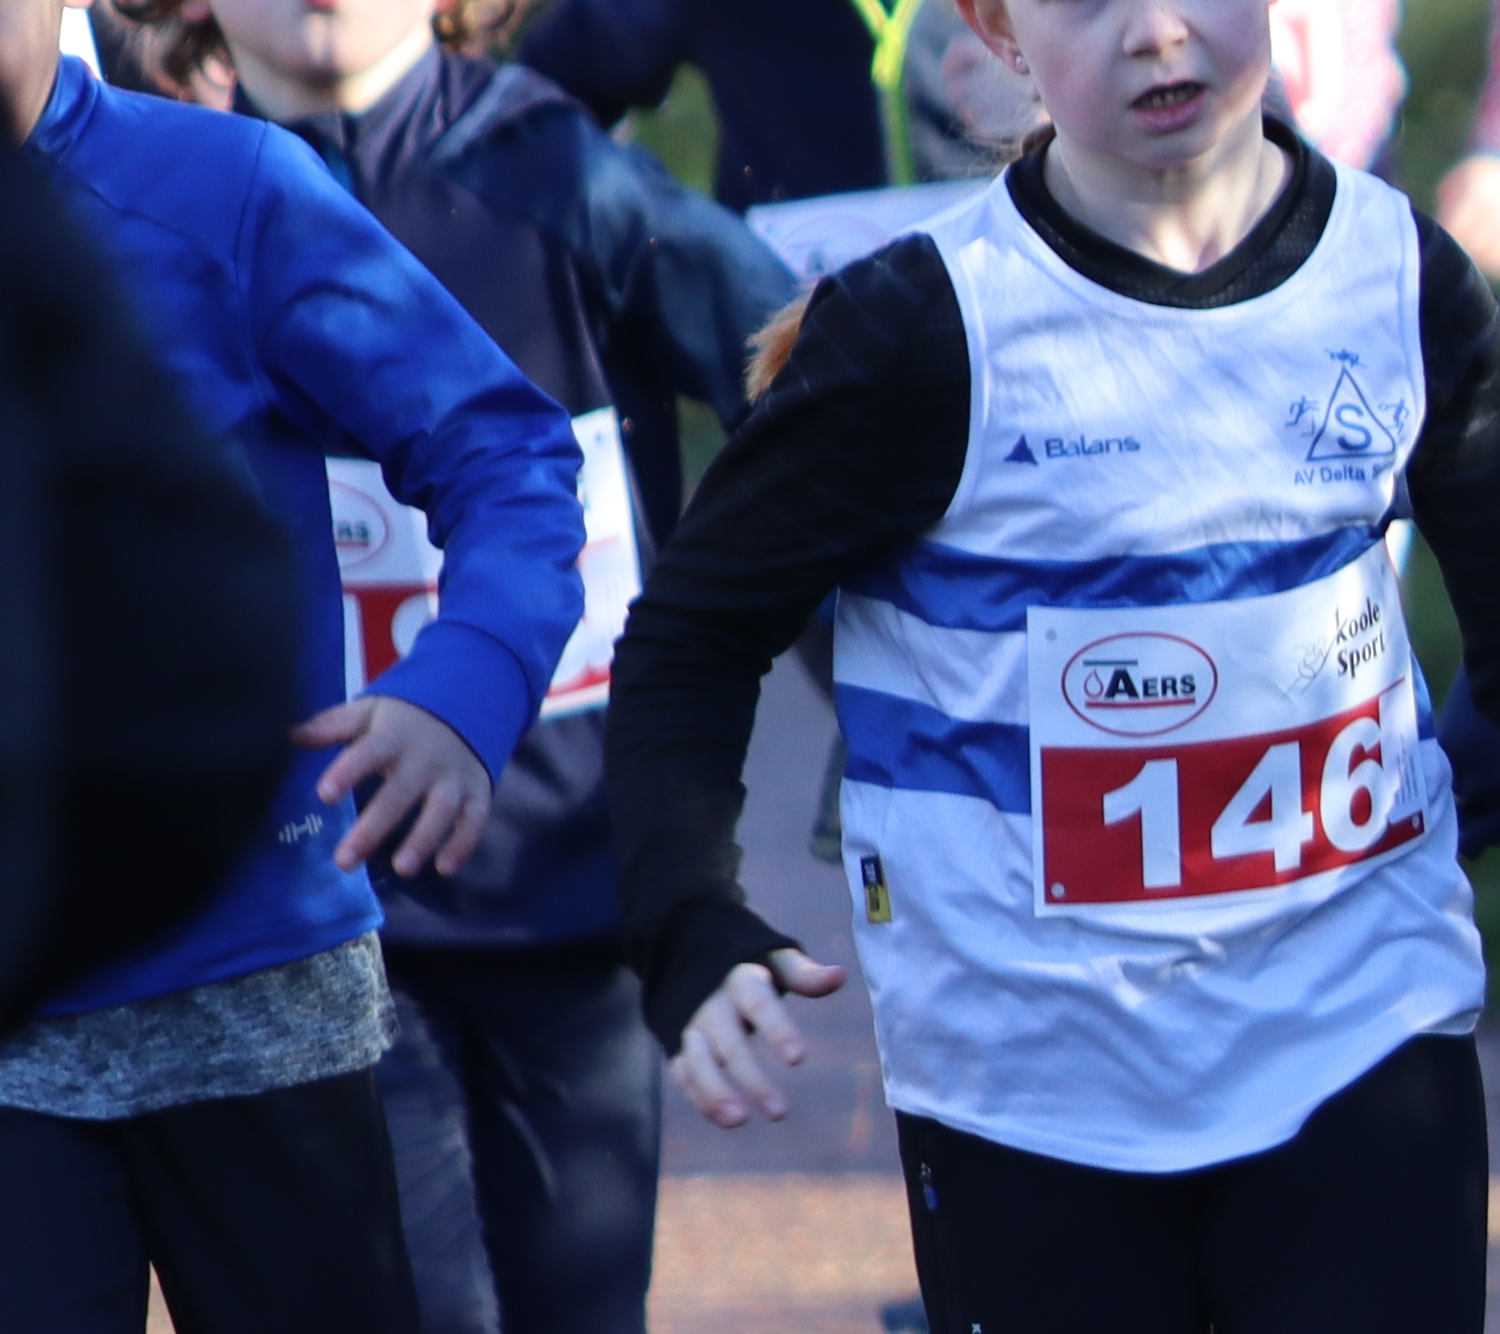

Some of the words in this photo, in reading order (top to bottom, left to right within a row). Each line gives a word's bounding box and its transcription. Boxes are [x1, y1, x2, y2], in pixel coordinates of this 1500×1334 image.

[1045, 434, 1141, 458] Balans
[1335, 404, 1372, 451] S
[1294, 469, 1314, 485] AV
[1320, 464, 1366, 483] Delta
[1337, 628, 1386, 679] Sport
[1104, 663, 1197, 699] AERS
[1102, 717, 1387, 890] 146
